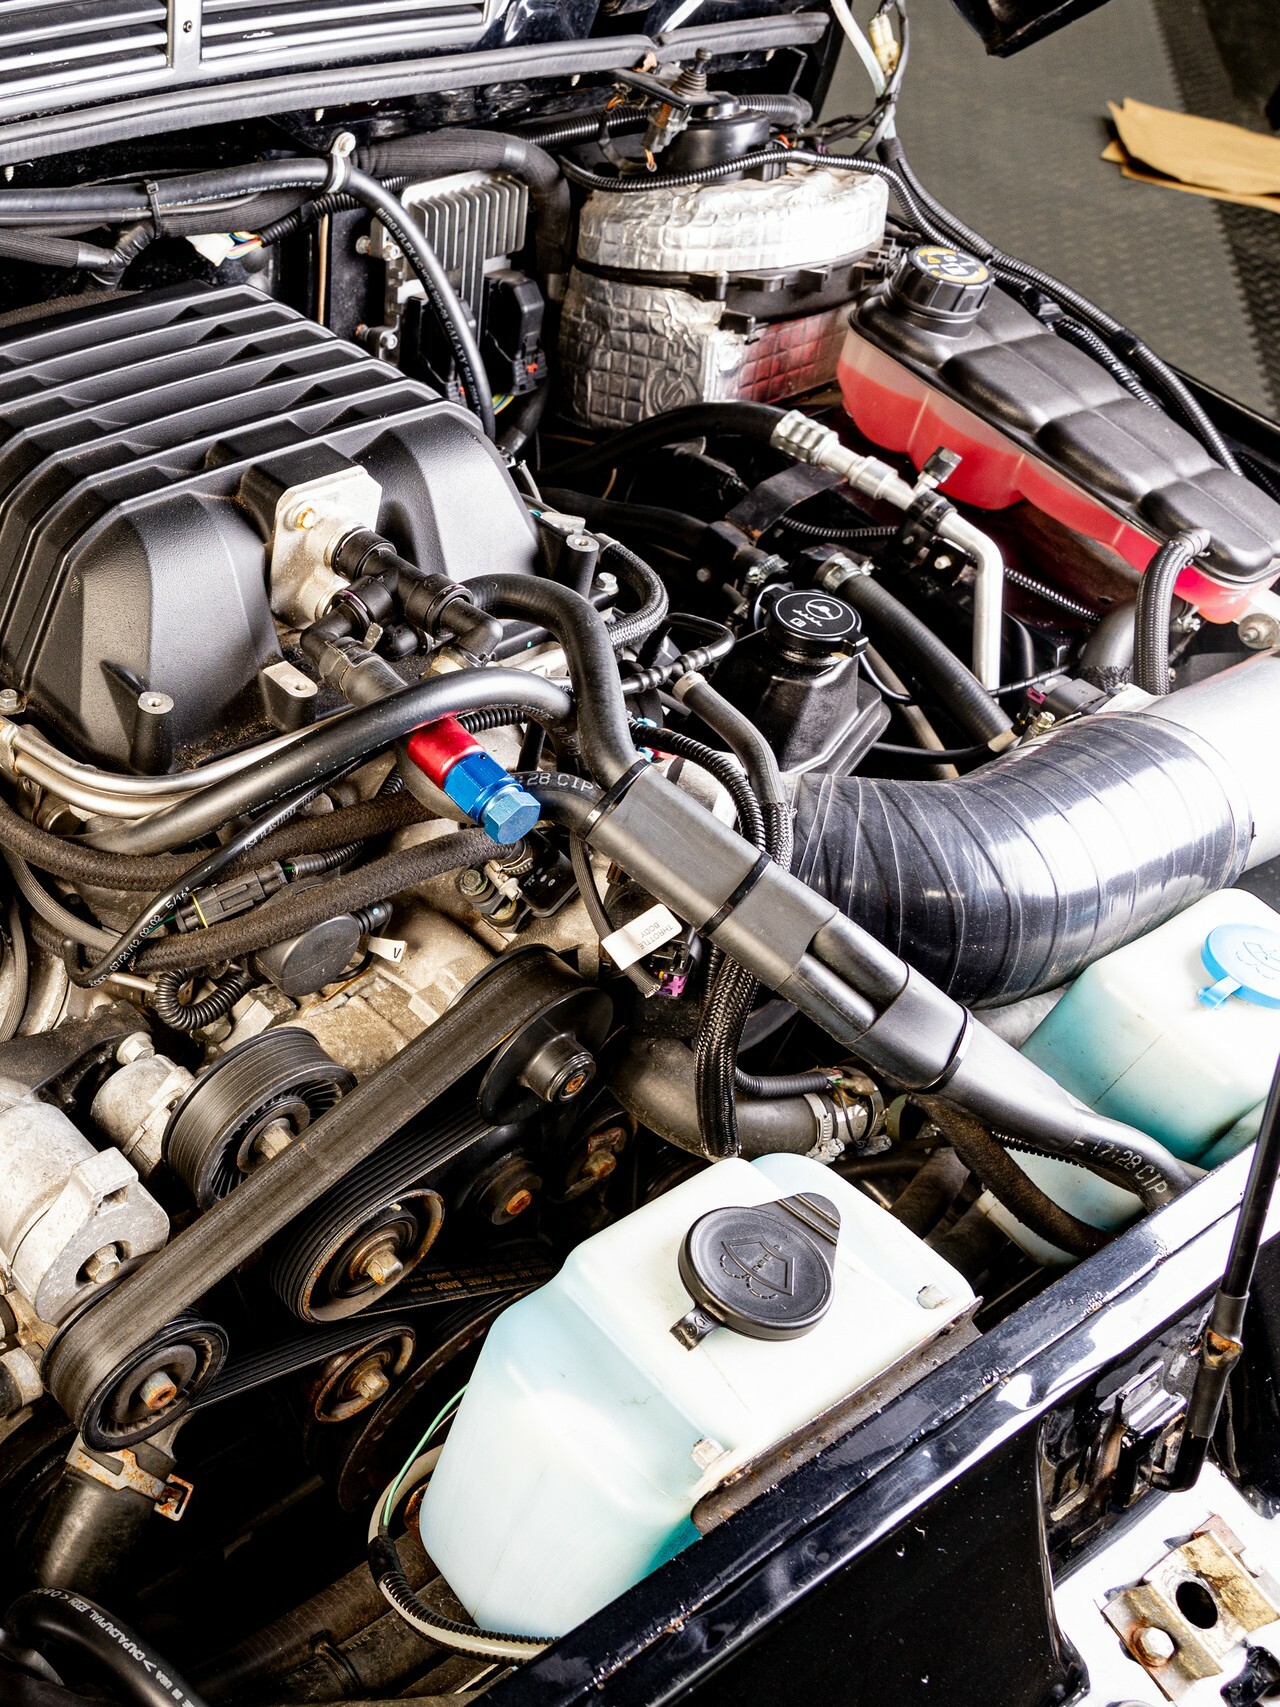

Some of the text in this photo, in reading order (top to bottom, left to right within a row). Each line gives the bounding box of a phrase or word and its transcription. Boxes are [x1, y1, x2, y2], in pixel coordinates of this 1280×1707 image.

[220, 192, 239, 200] Type
[247, 186, 268, 194] Class
[419, 267, 435, 293] HOSE
[444, 319, 469, 364] GALAXY
[637, 924, 673, 950] THROTTLE
[640, 921, 661, 938] BODY
[109, 938, 141, 973] 07/21/12
[139, 914, 162, 938] 02:02
